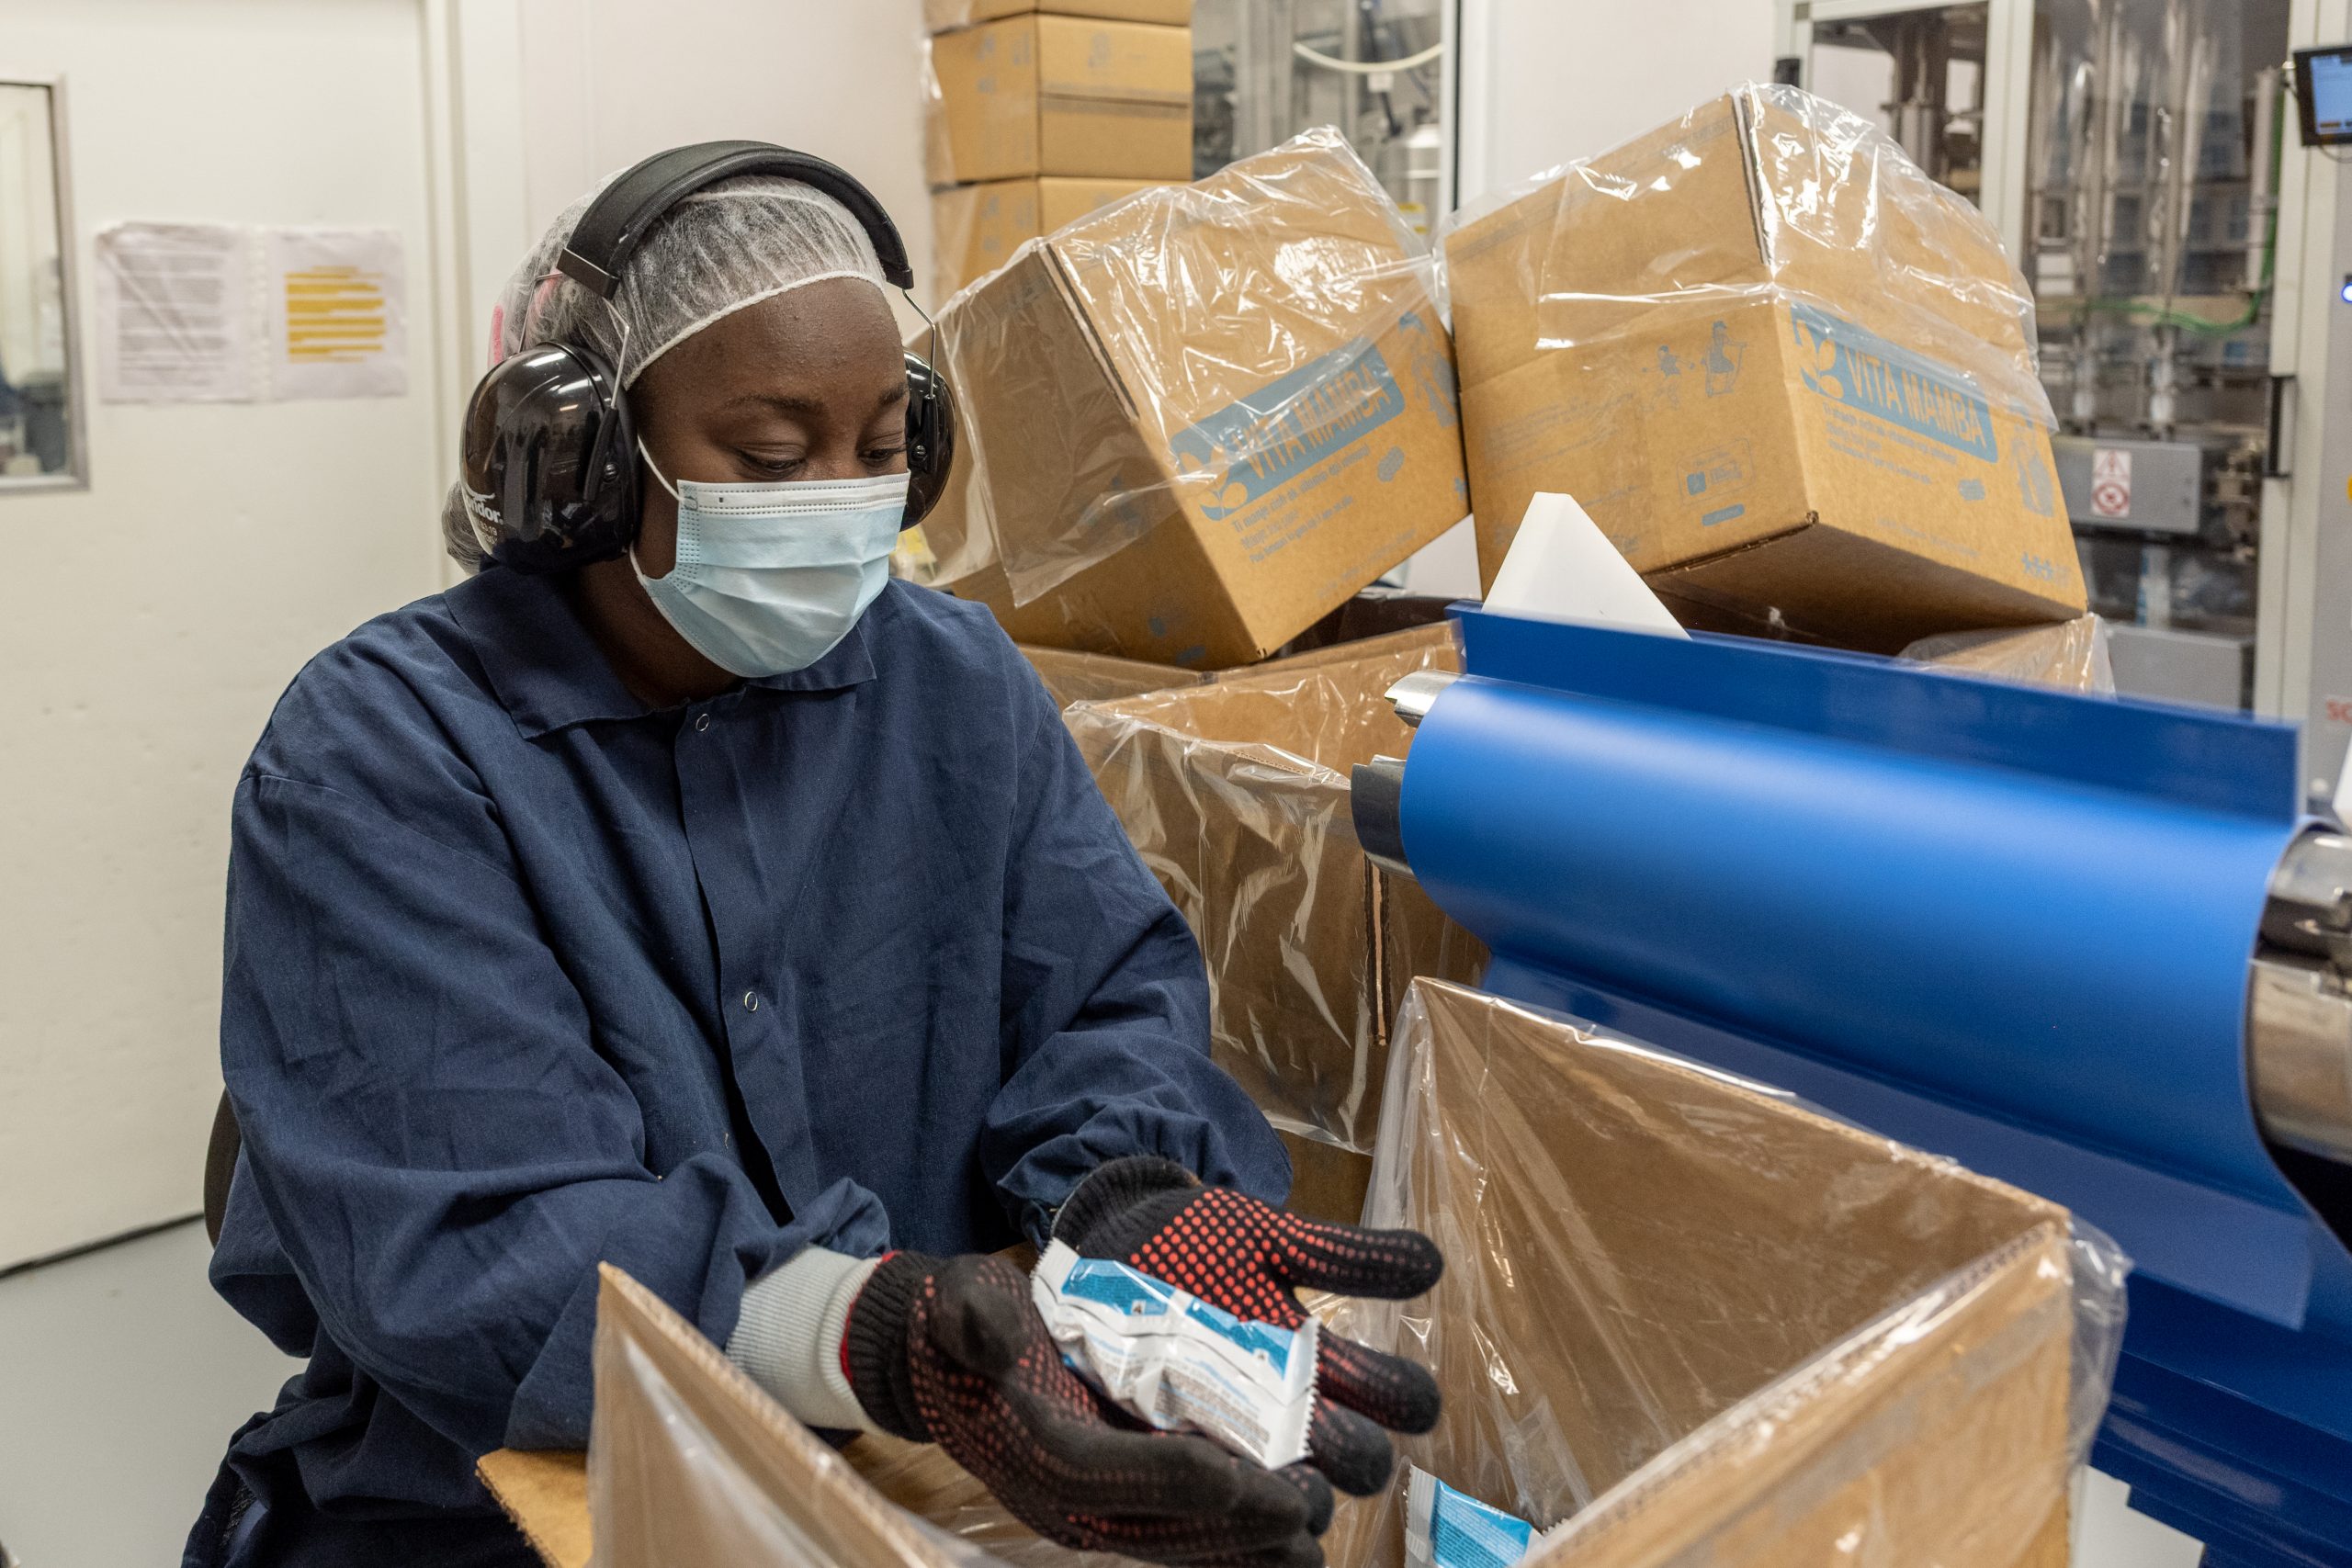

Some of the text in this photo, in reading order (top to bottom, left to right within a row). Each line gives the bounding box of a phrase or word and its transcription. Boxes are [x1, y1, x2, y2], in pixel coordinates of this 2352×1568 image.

[1232, 361, 1393, 479] VITA MAMBA
[1845, 347, 1904, 414] VITA
[1901, 371, 1988, 449] MAMBA
